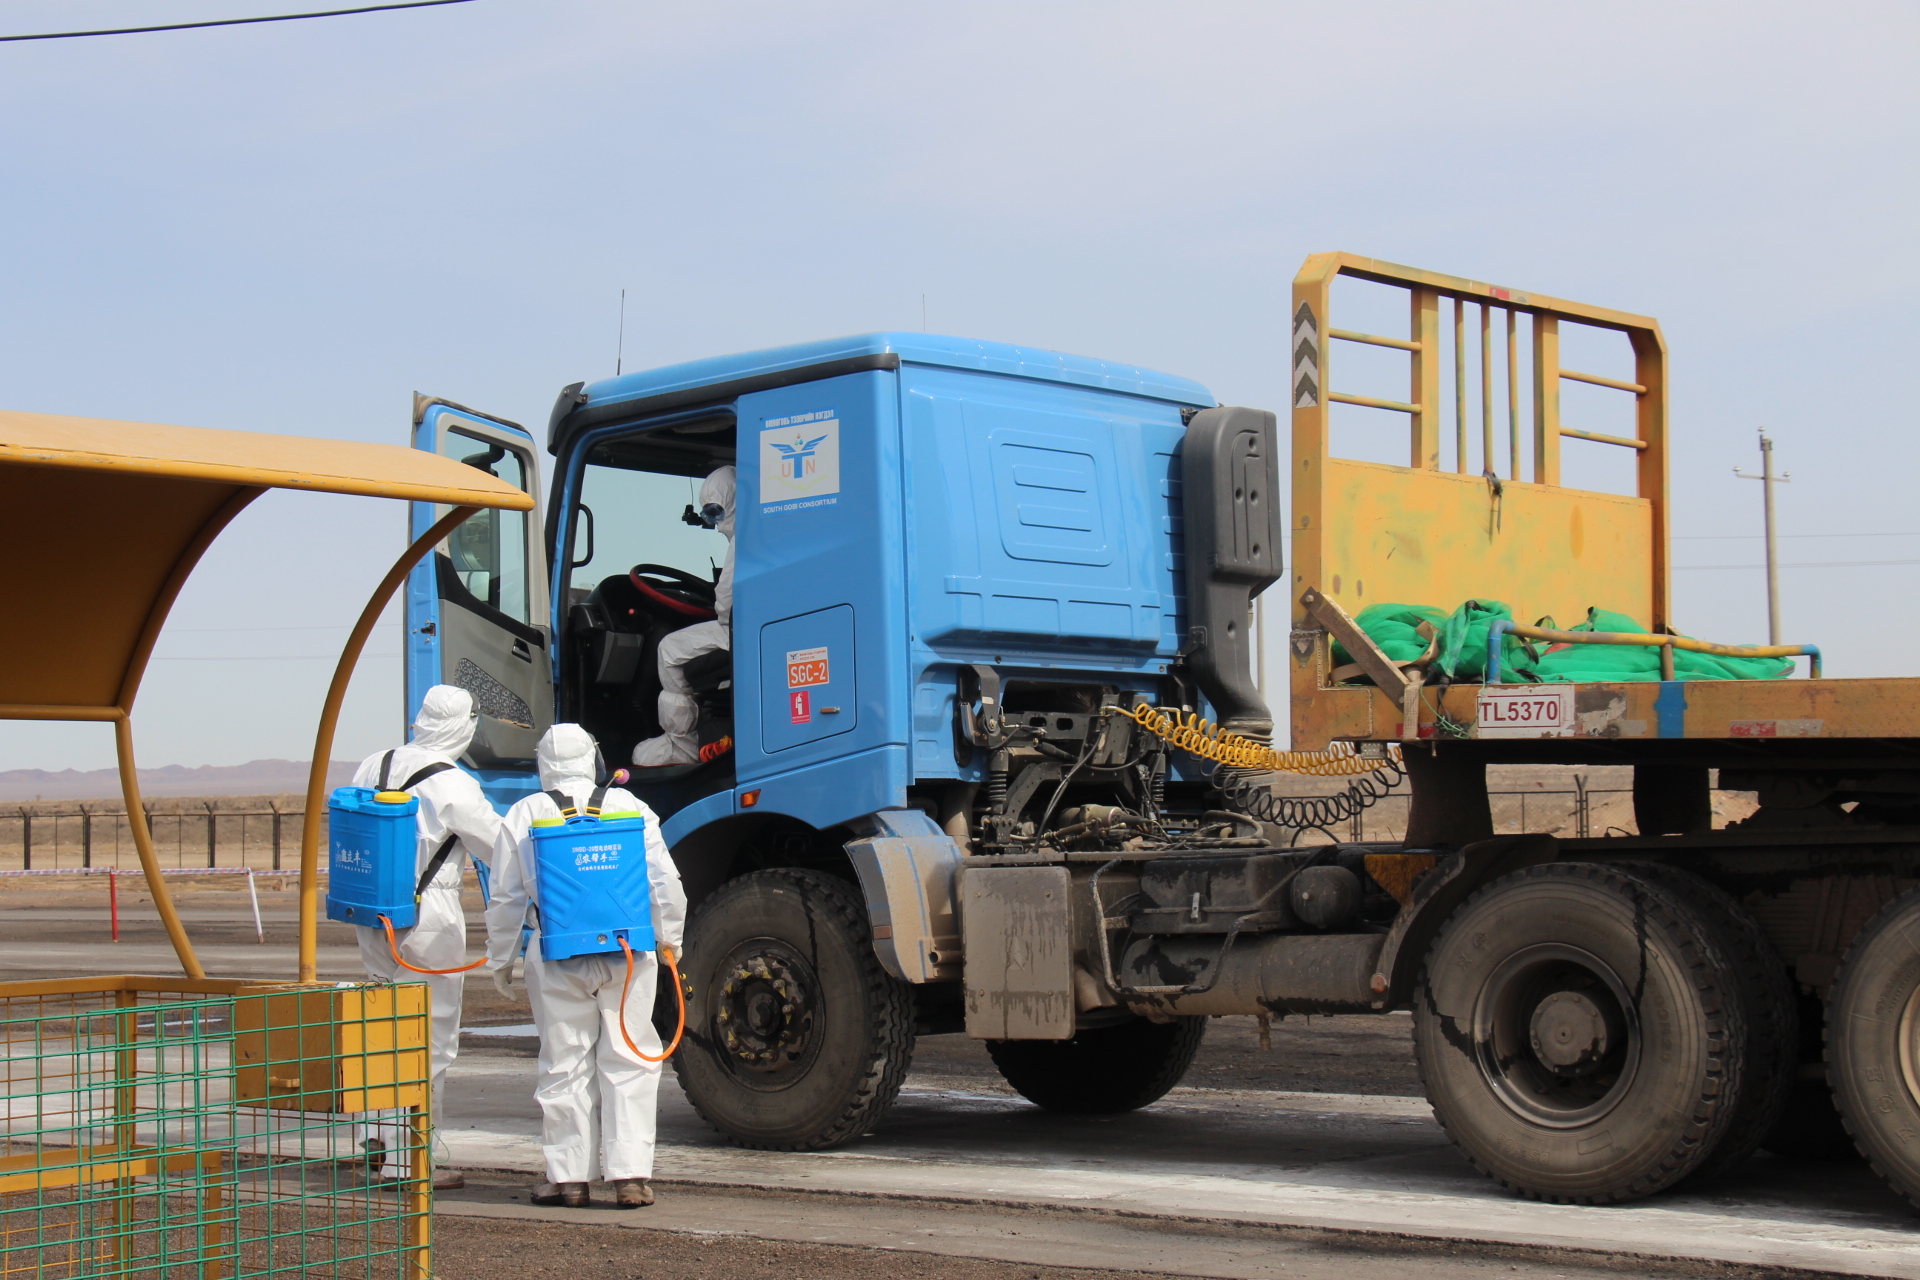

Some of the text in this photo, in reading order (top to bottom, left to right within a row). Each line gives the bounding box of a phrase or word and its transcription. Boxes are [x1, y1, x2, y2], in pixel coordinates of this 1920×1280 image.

[763, 497, 838, 514] SOUTH GOBI CONSORTIUM
[790, 662, 826, 684] SGC-2
[1480, 701, 1558, 721] TL5370
